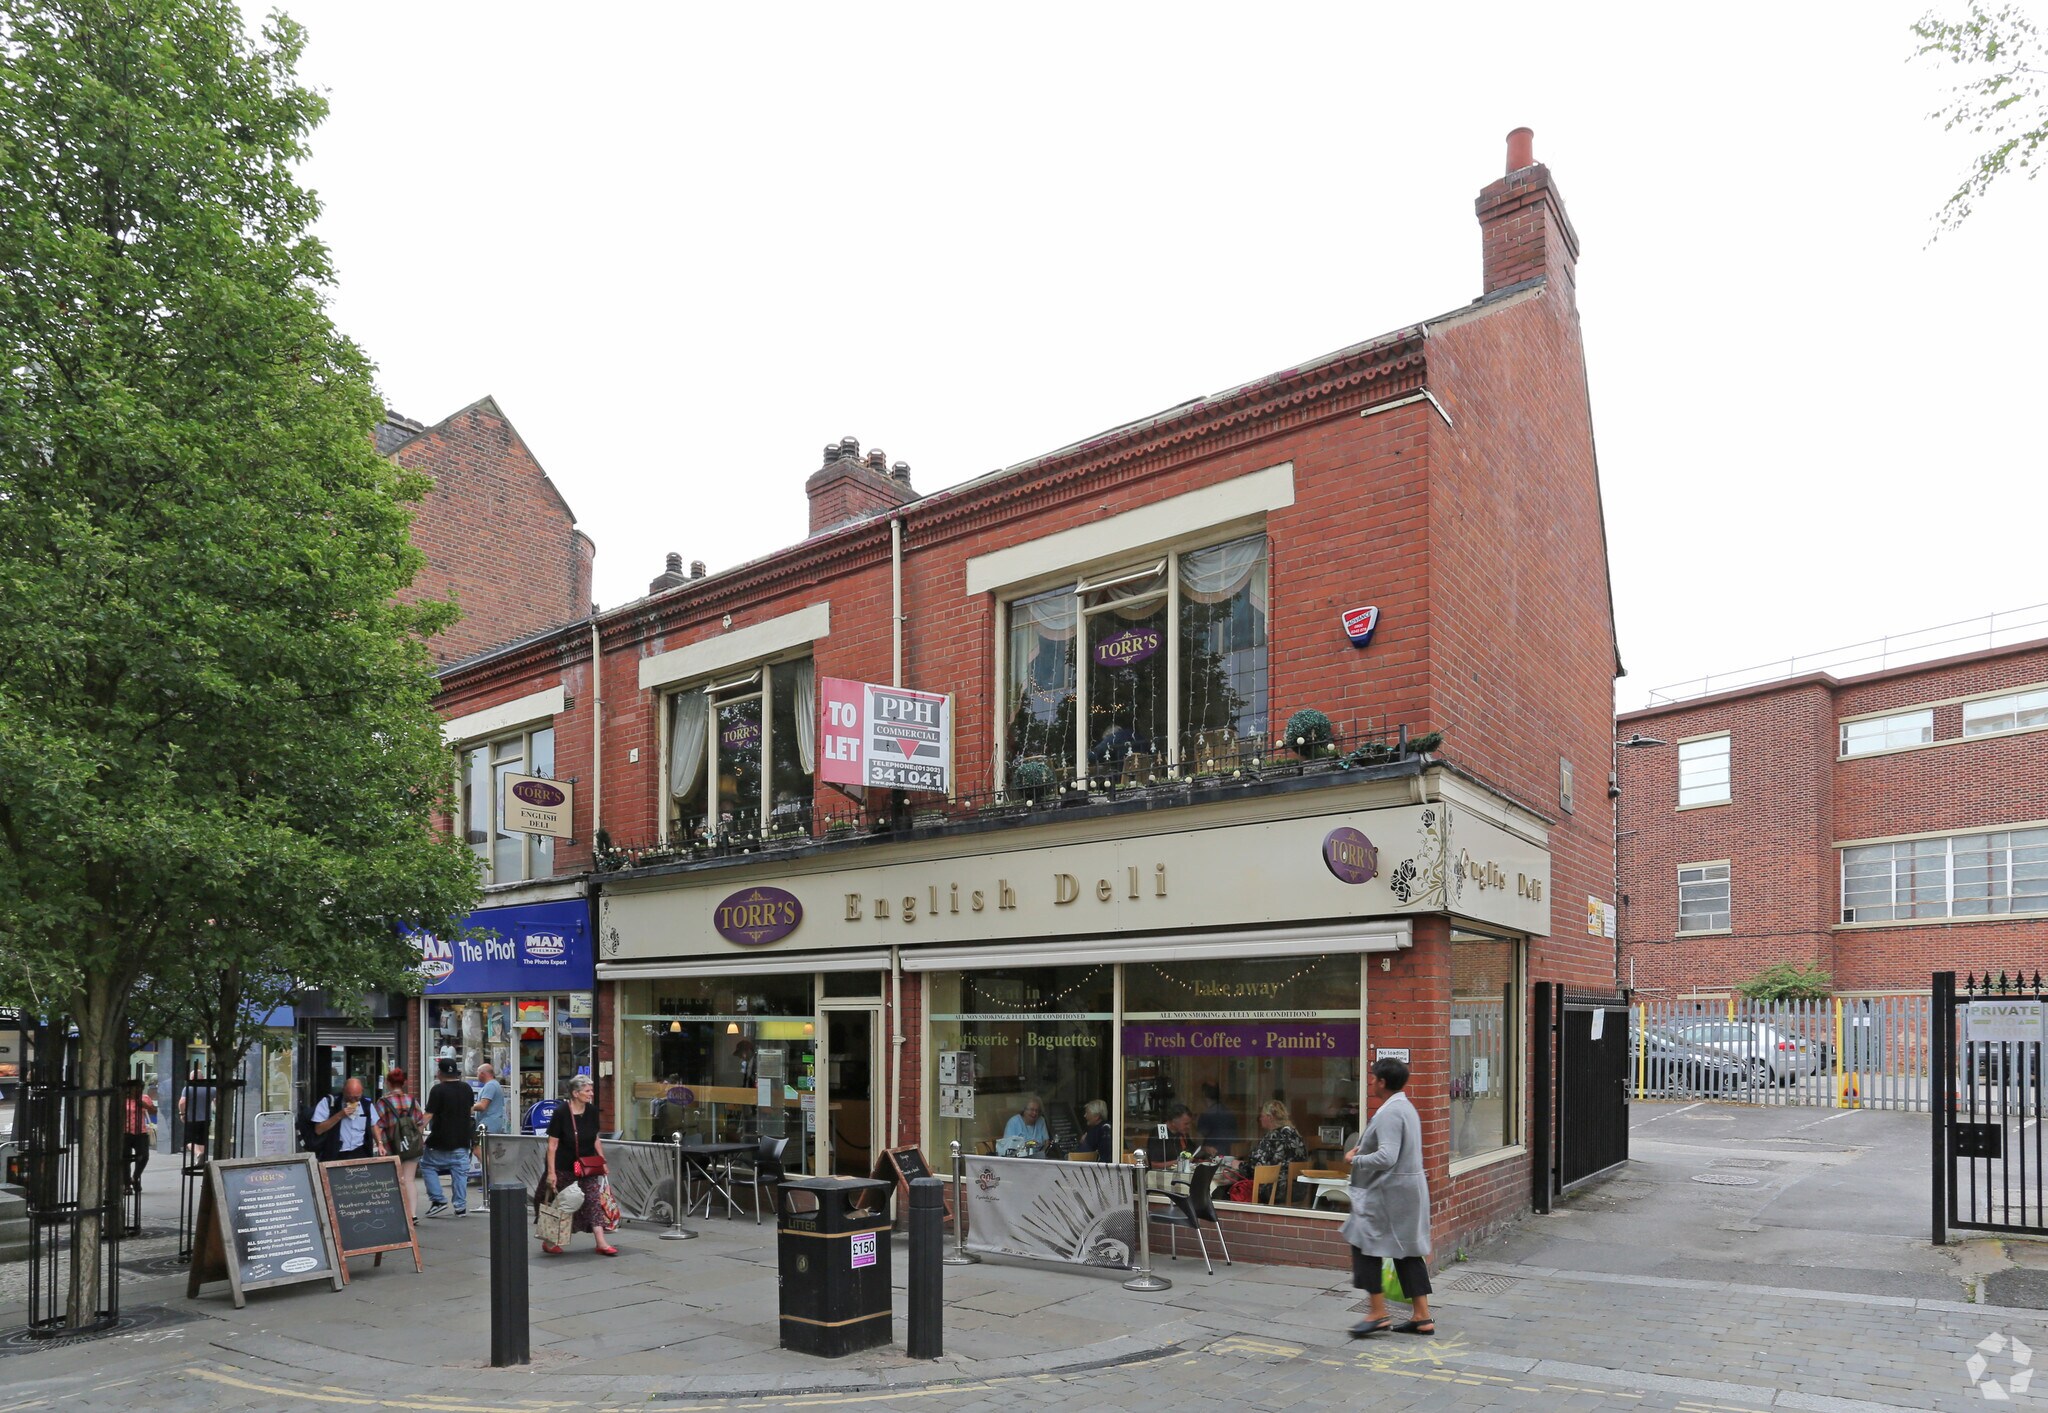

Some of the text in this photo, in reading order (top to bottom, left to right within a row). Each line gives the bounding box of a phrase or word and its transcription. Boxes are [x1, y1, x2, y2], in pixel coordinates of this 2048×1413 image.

[1099, 634, 1158, 659] TORR'S
[828, 701, 857, 728] TO
[881, 697, 934, 724] PPH
[723, 725, 759, 742] TORR'S
[876, 726, 938, 740] COMMERCIAL
[826, 735, 860, 762] LET
[871, 767, 941, 786] 341041
[516, 786, 561, 802] TORR'S
[521, 810, 557, 822] ENGLISH
[530, 820, 549, 828] DELI
[1330, 838, 1375, 871] TORR'S
[844, 863, 1167, 923] English Deli
[1518, 872, 1542, 902] Deli
[719, 900, 796, 930] TORR'S
[458, 937, 516, 962] The Phot
[526, 936, 564, 948] MAX
[1026, 985, 1041, 1000] in
[1190, 980, 1280, 998] Take away
[1971, 1006, 2040, 1016] PRIVATE
[1027, 1032, 1097, 1050] Baguettes
[1144, 1032, 1336, 1049] Fresh Coffee Panini's
[250, 1173, 284, 1182] TORR'S
[345, 1165, 368, 1176] Special
[788, 1220, 817, 1231] LITTER
[852, 1240, 875, 1256] £150
